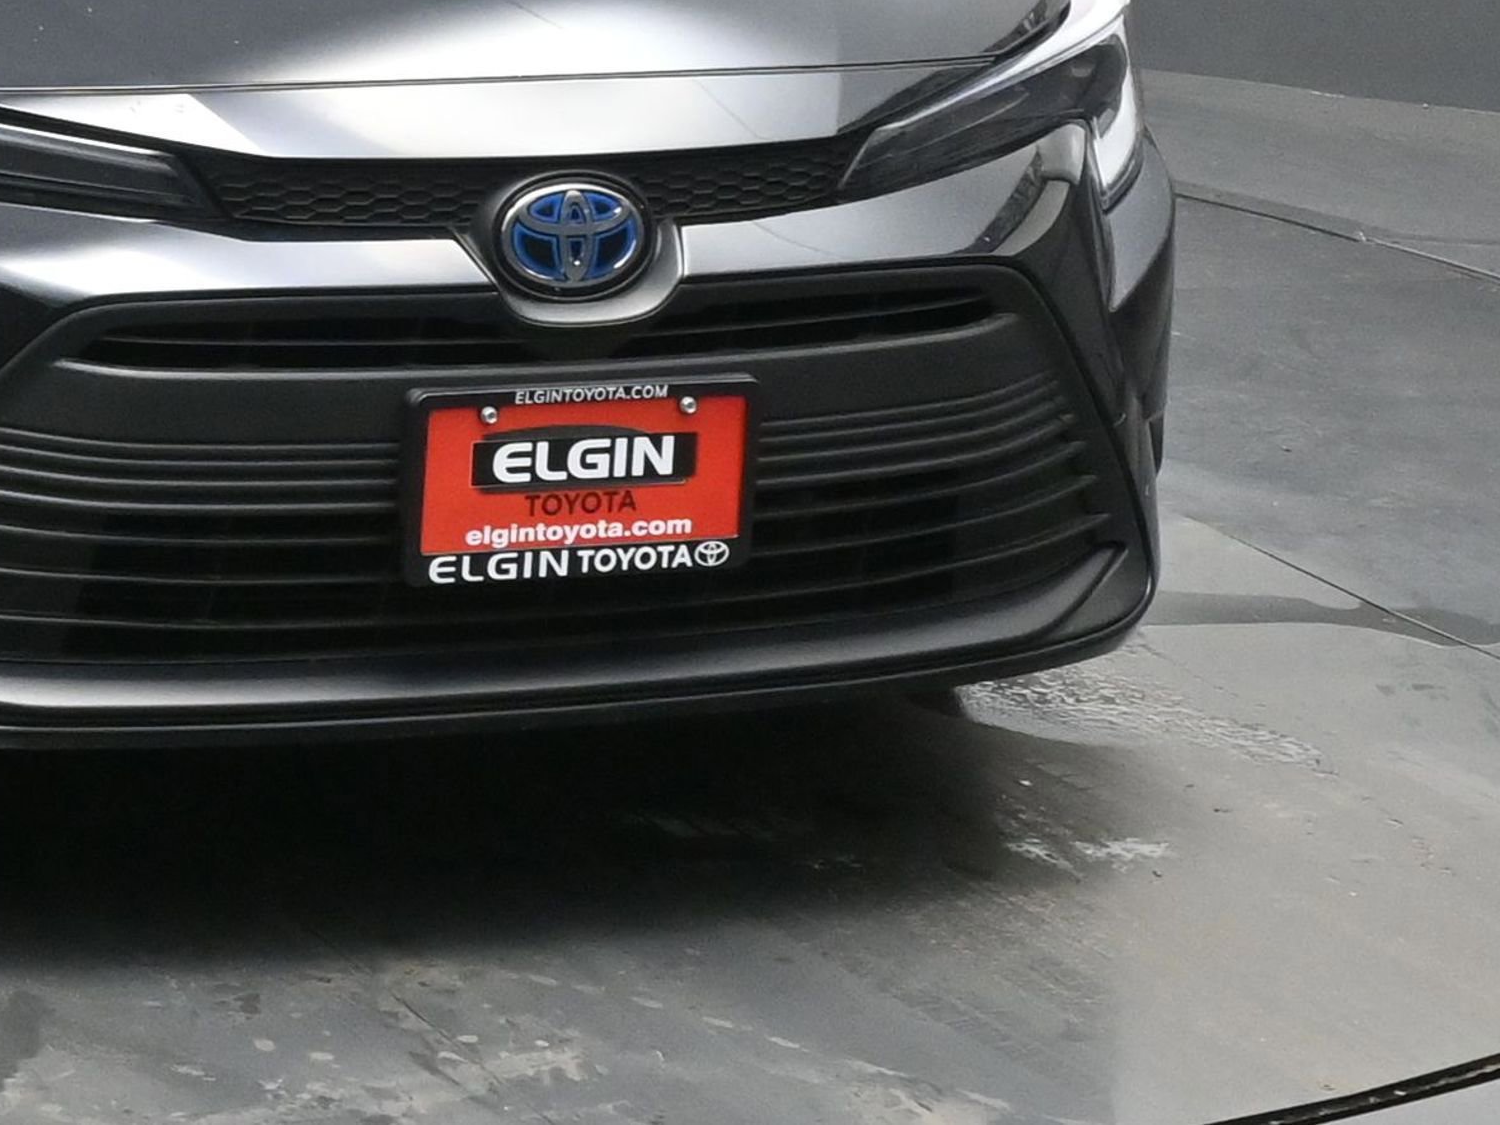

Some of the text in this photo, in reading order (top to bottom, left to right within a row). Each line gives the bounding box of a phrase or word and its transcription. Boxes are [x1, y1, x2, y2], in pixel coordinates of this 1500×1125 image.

[515, 385, 669, 405] ELGINTOYOTA.COM
[492, 435, 676, 483] ELGIN
[524, 490, 638, 517] TOYOTA
[464, 518, 693, 548] elgintoyota.com
[428, 545, 693, 584] ELGIN TOYOTA
